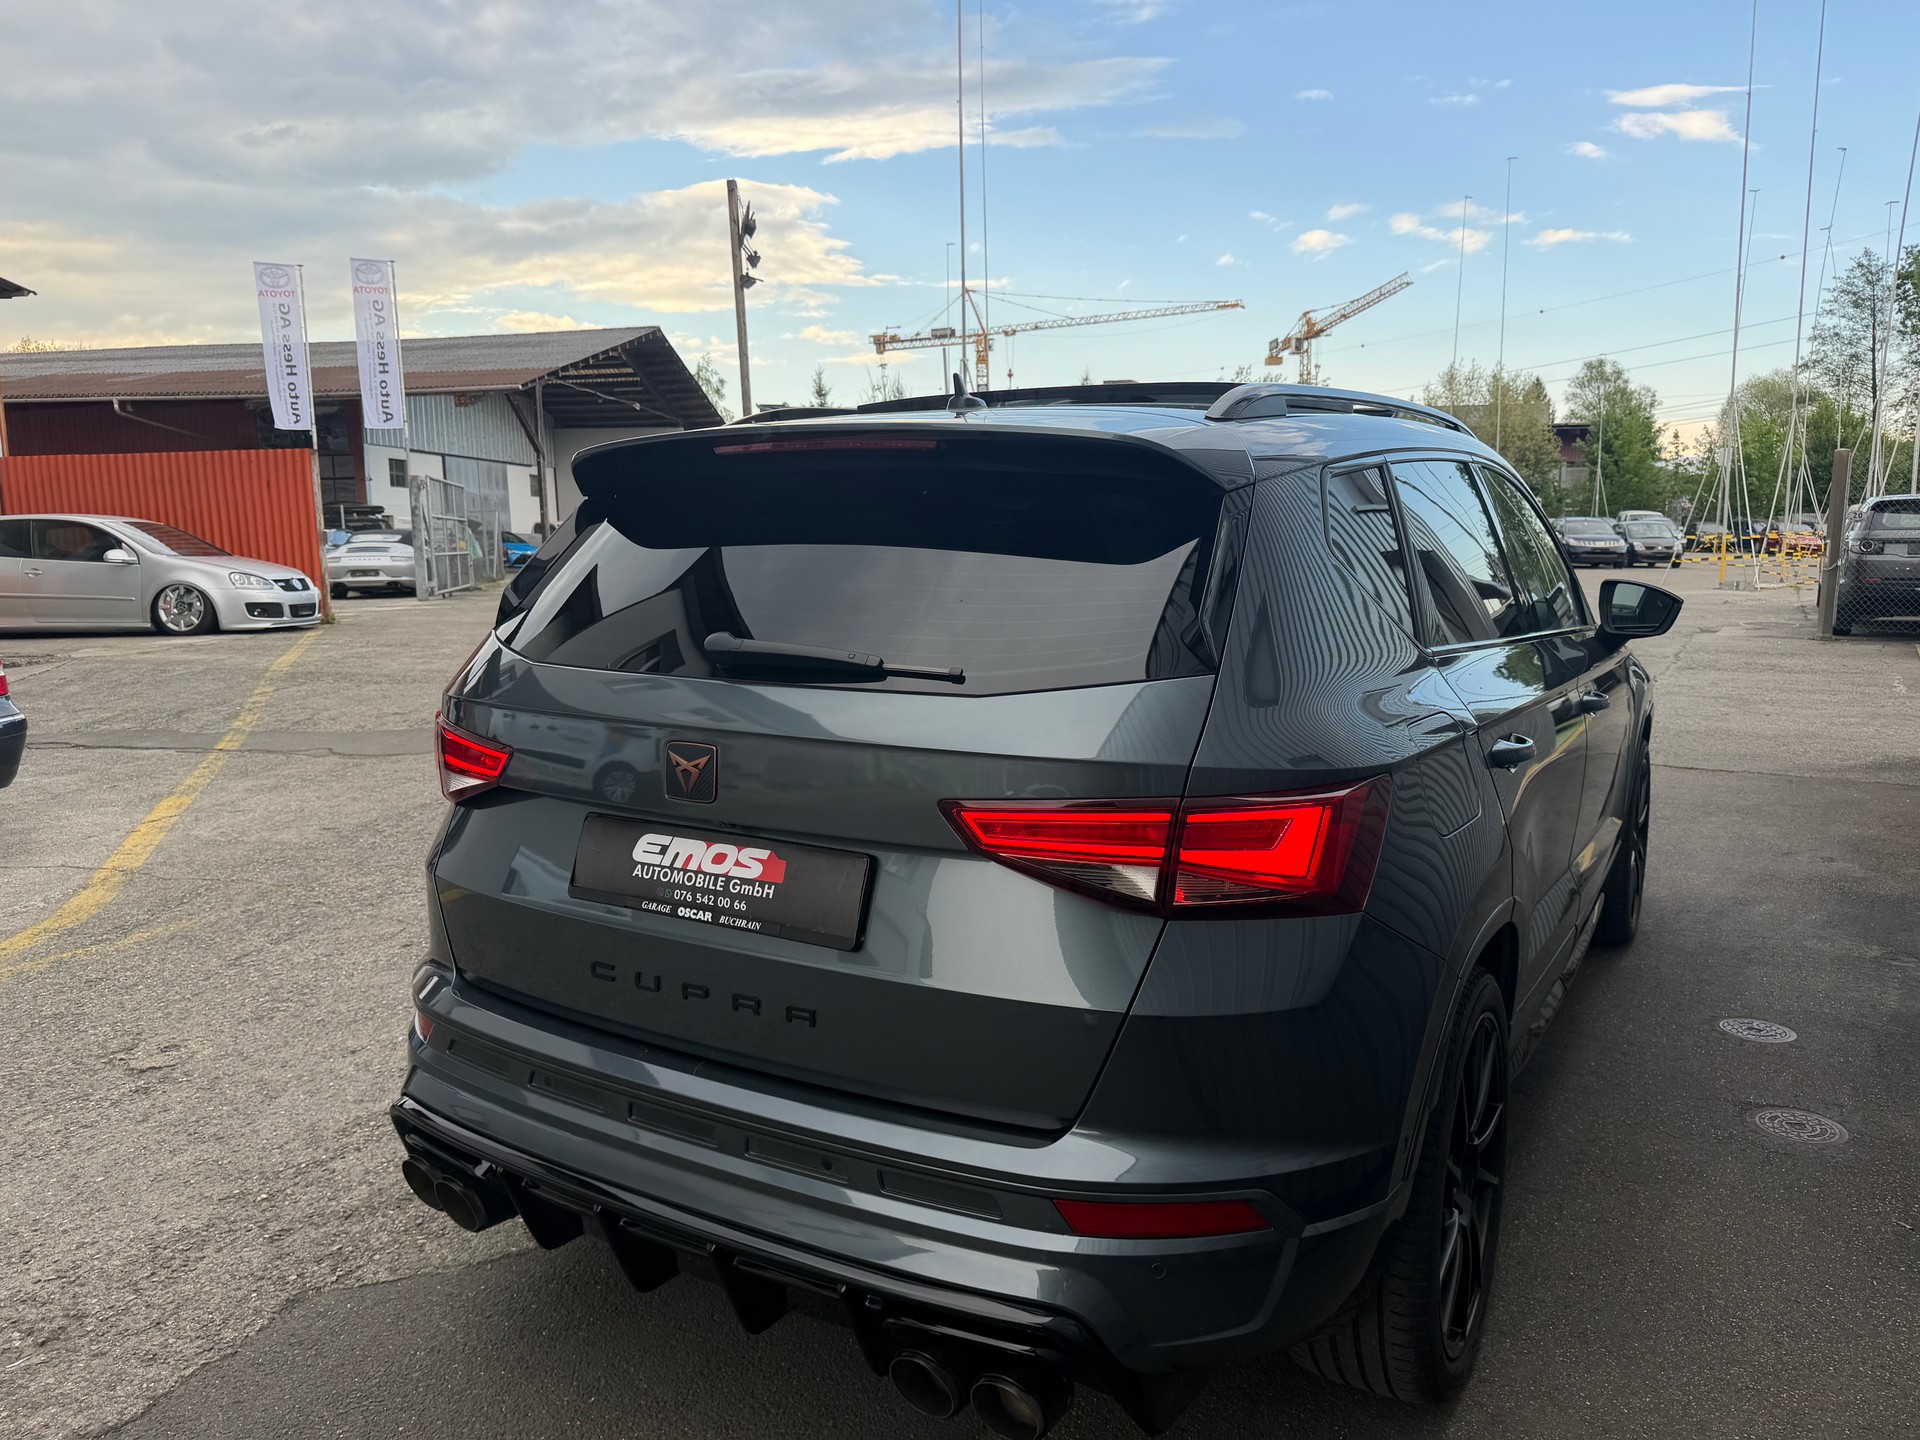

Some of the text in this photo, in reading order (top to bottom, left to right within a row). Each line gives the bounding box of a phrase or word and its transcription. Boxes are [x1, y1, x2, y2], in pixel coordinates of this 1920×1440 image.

[632, 833, 772, 879] EMOS
[632, 864, 776, 899] AUTOMOBILE GmbH
[641, 900, 762, 931] GARAGE OSCAR BUCHRAIN
[673, 889, 747, 911] 076 542 00 66
[590, 960, 817, 1028] CUPRA
